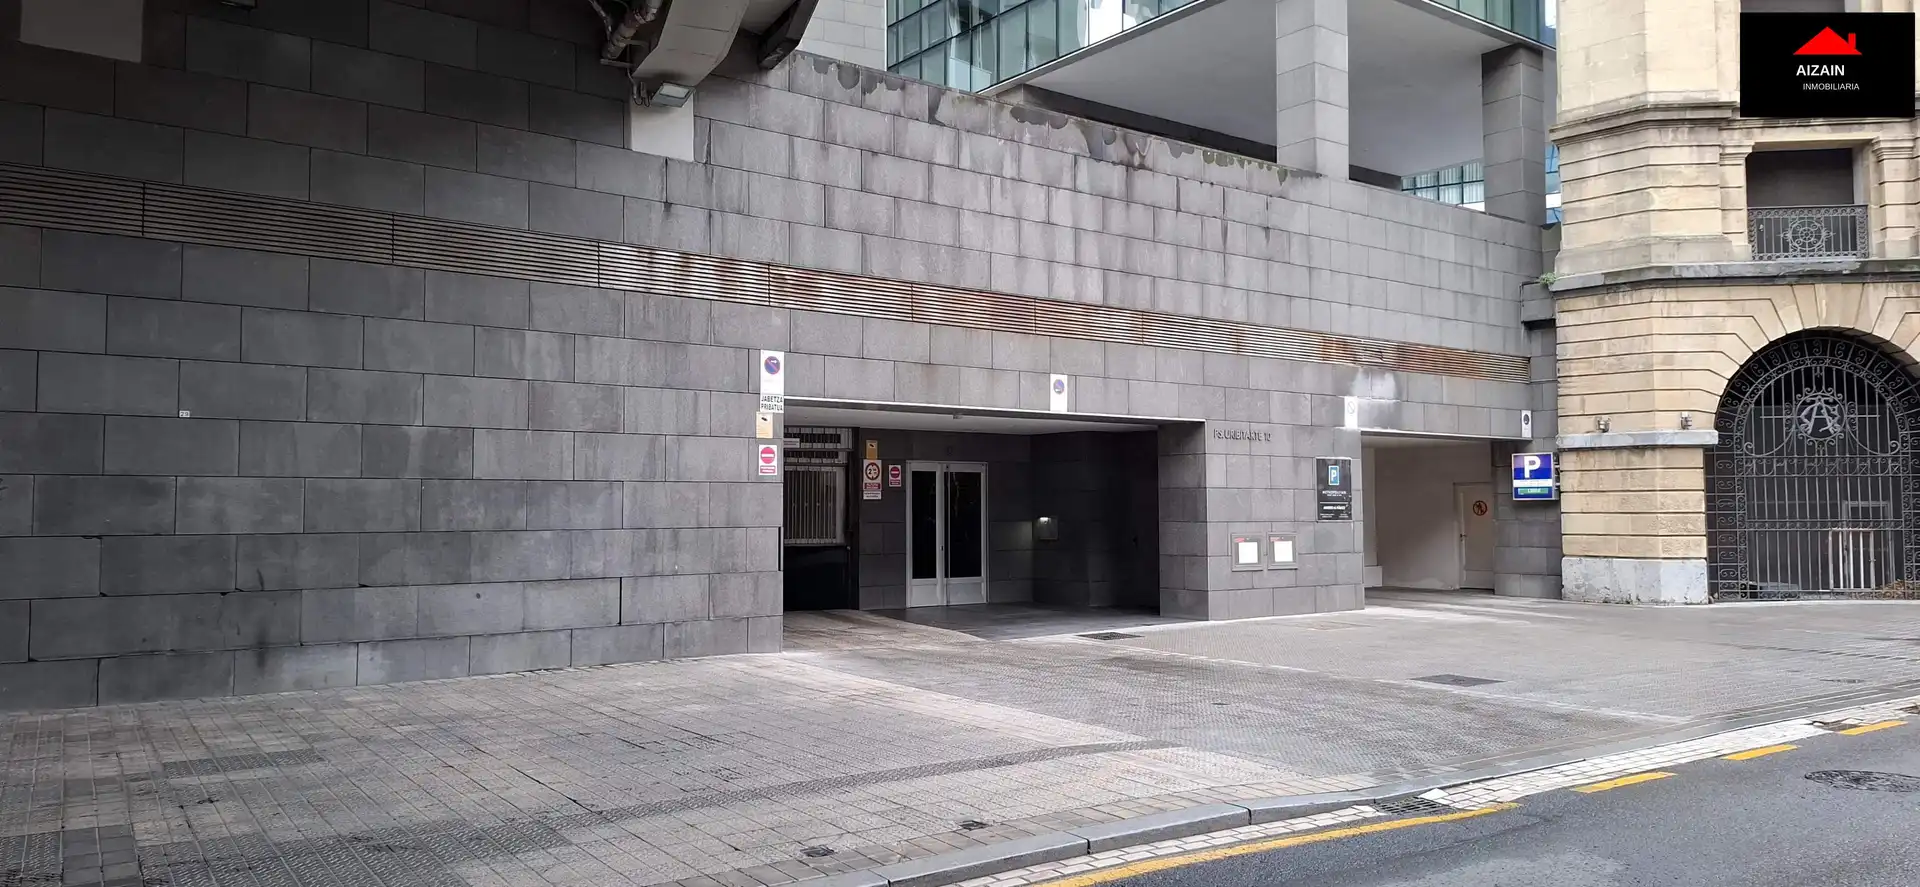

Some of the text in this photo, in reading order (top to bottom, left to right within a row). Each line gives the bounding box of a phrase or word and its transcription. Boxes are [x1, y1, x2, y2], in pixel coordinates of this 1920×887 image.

[761, 395, 783, 403] JABETZA
[761, 403, 783, 411] PRIBATUA
[1524, 455, 1541, 478] P
[1331, 469, 1338, 482] P
